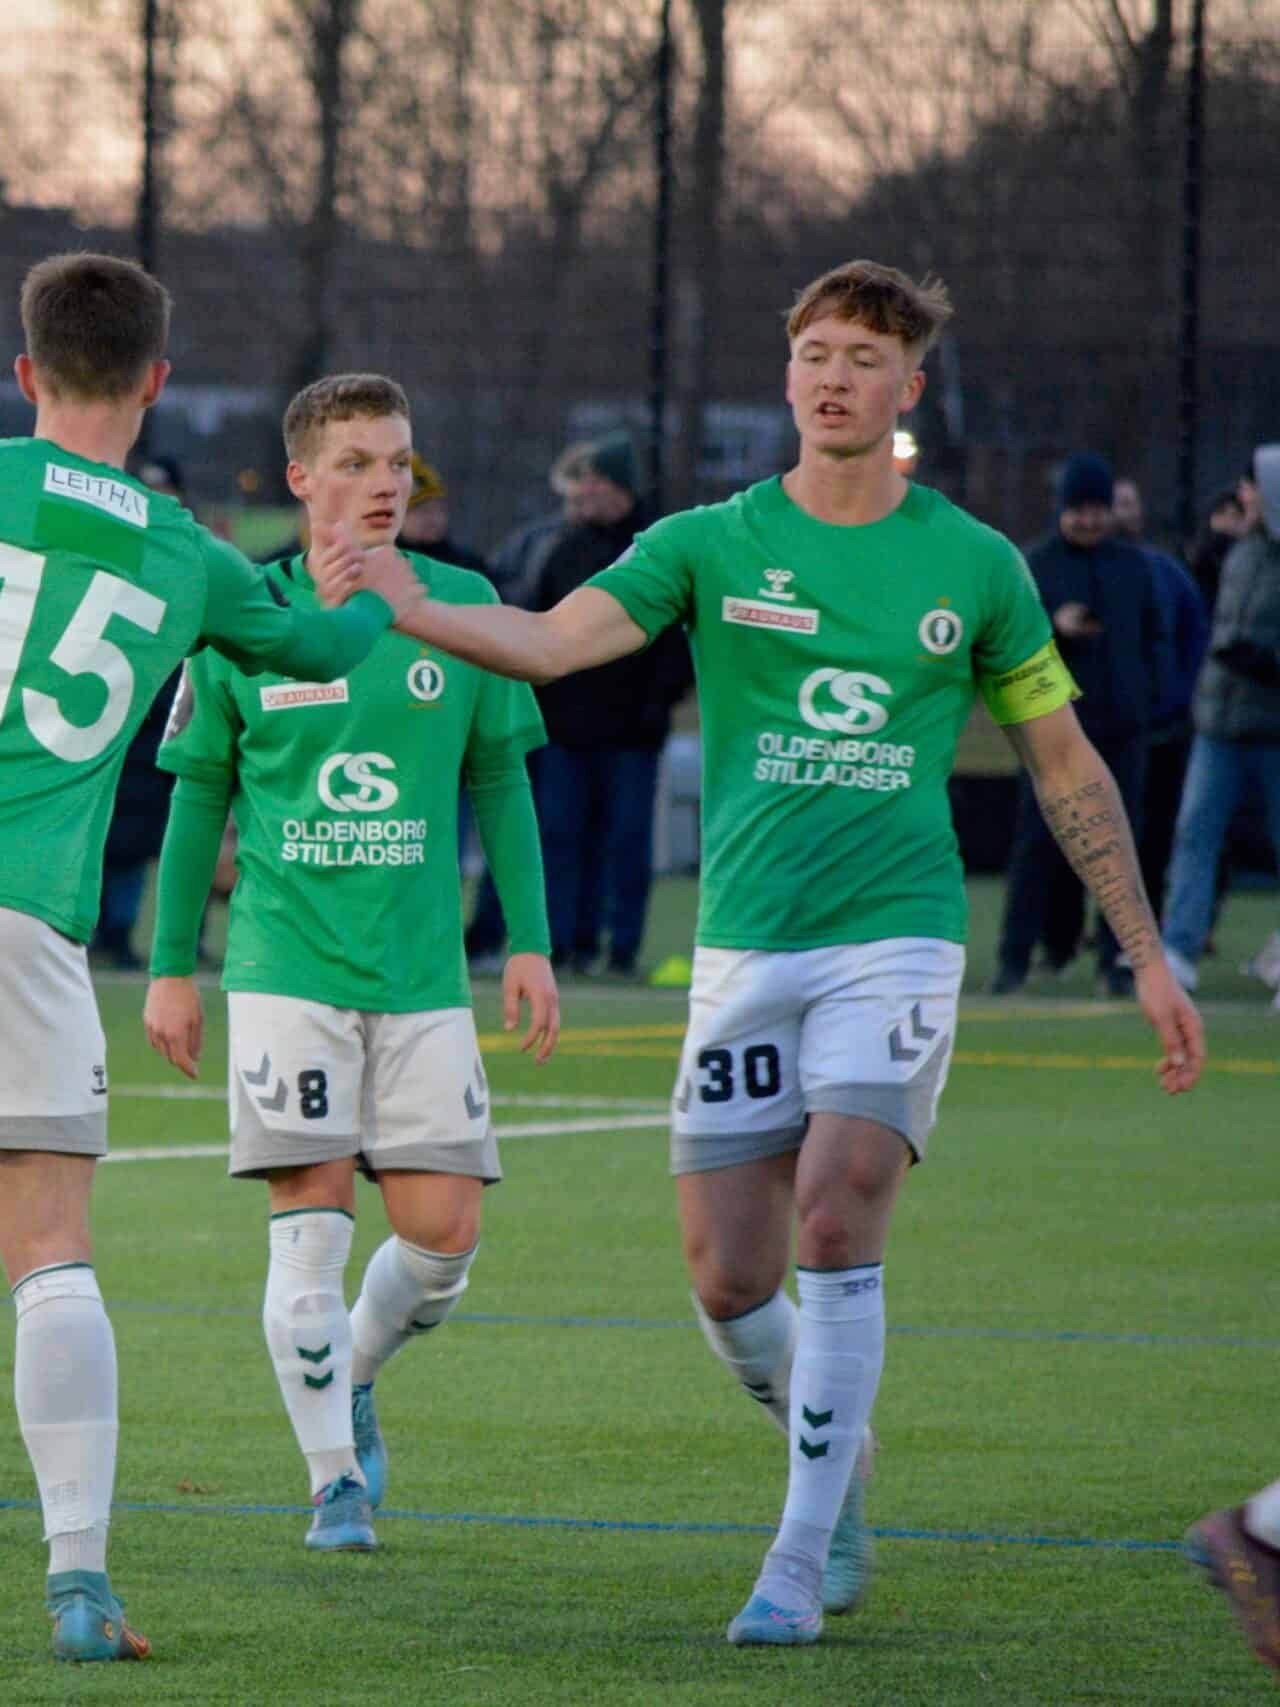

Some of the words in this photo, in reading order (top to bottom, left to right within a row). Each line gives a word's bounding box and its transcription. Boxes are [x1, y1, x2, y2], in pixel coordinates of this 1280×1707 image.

[757, 732, 915, 768] OLDENBORG
[753, 757, 911, 792] STILLADSER
[282, 819, 427, 842] OLDENBORG
[281, 841, 425, 866] STILLADSER
[697, 1043, 781, 1104] 30
[297, 1068, 329, 1120] 8
